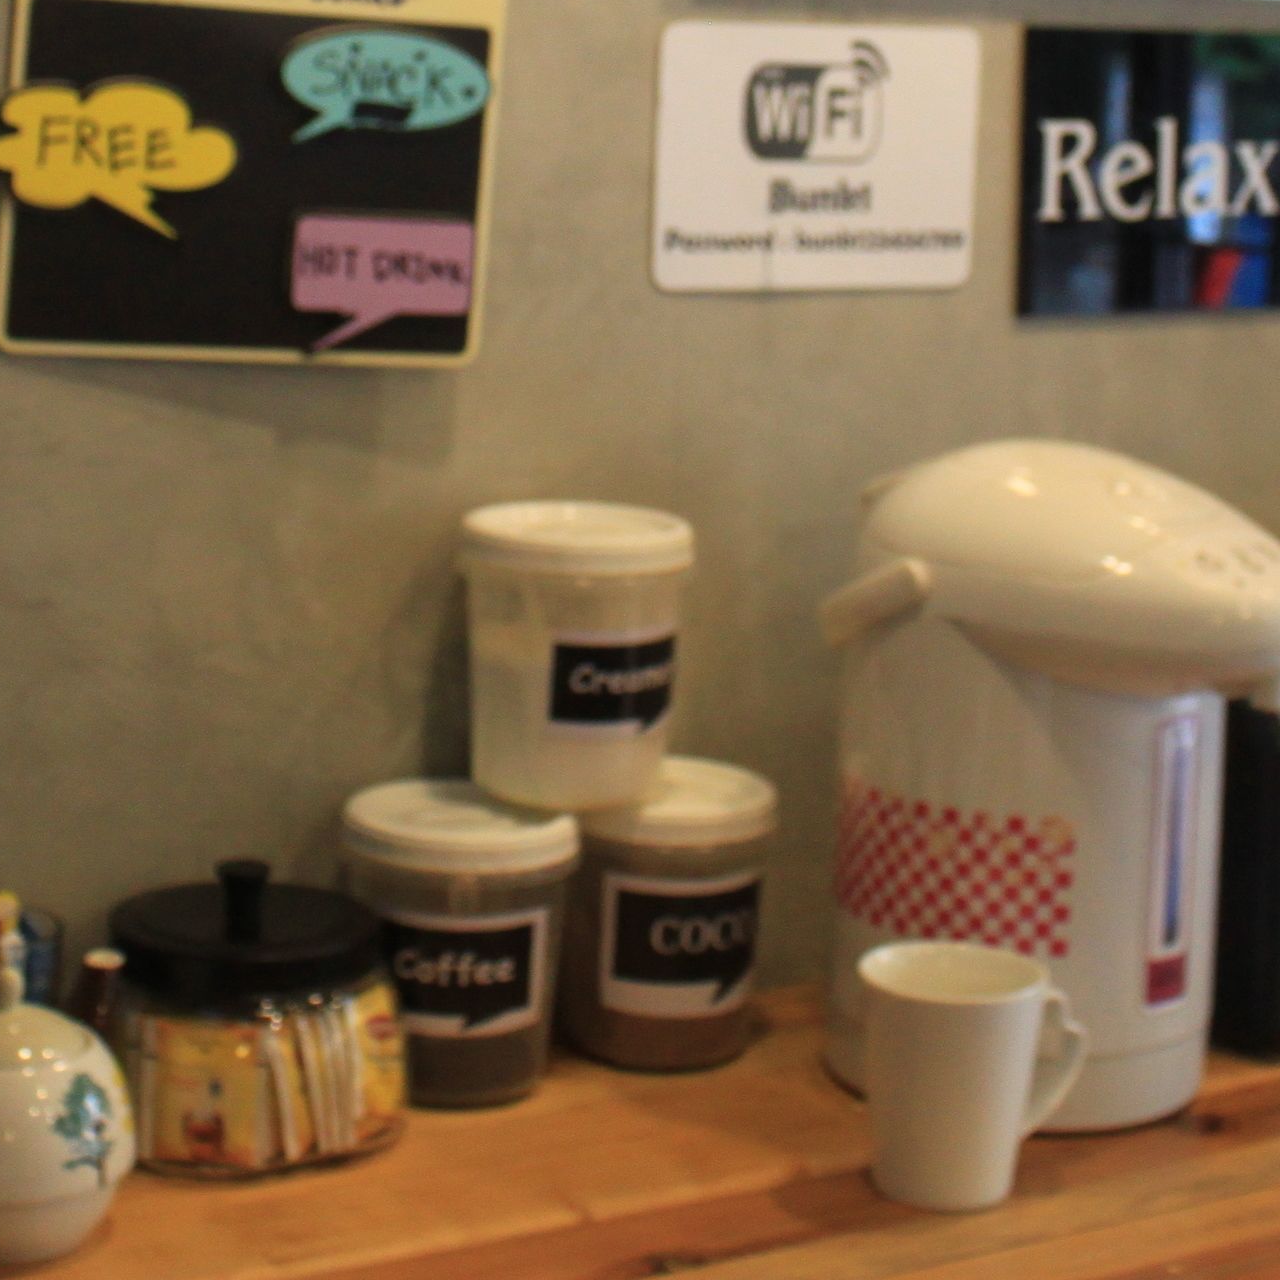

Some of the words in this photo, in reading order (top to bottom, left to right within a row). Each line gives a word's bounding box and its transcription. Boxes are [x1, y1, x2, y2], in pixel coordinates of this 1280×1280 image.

[34, 115, 178, 172] FREE
[1038, 116, 1280, 222] Relax
[297, 245, 359, 280] HOT
[394, 950, 517, 987] Coffee
